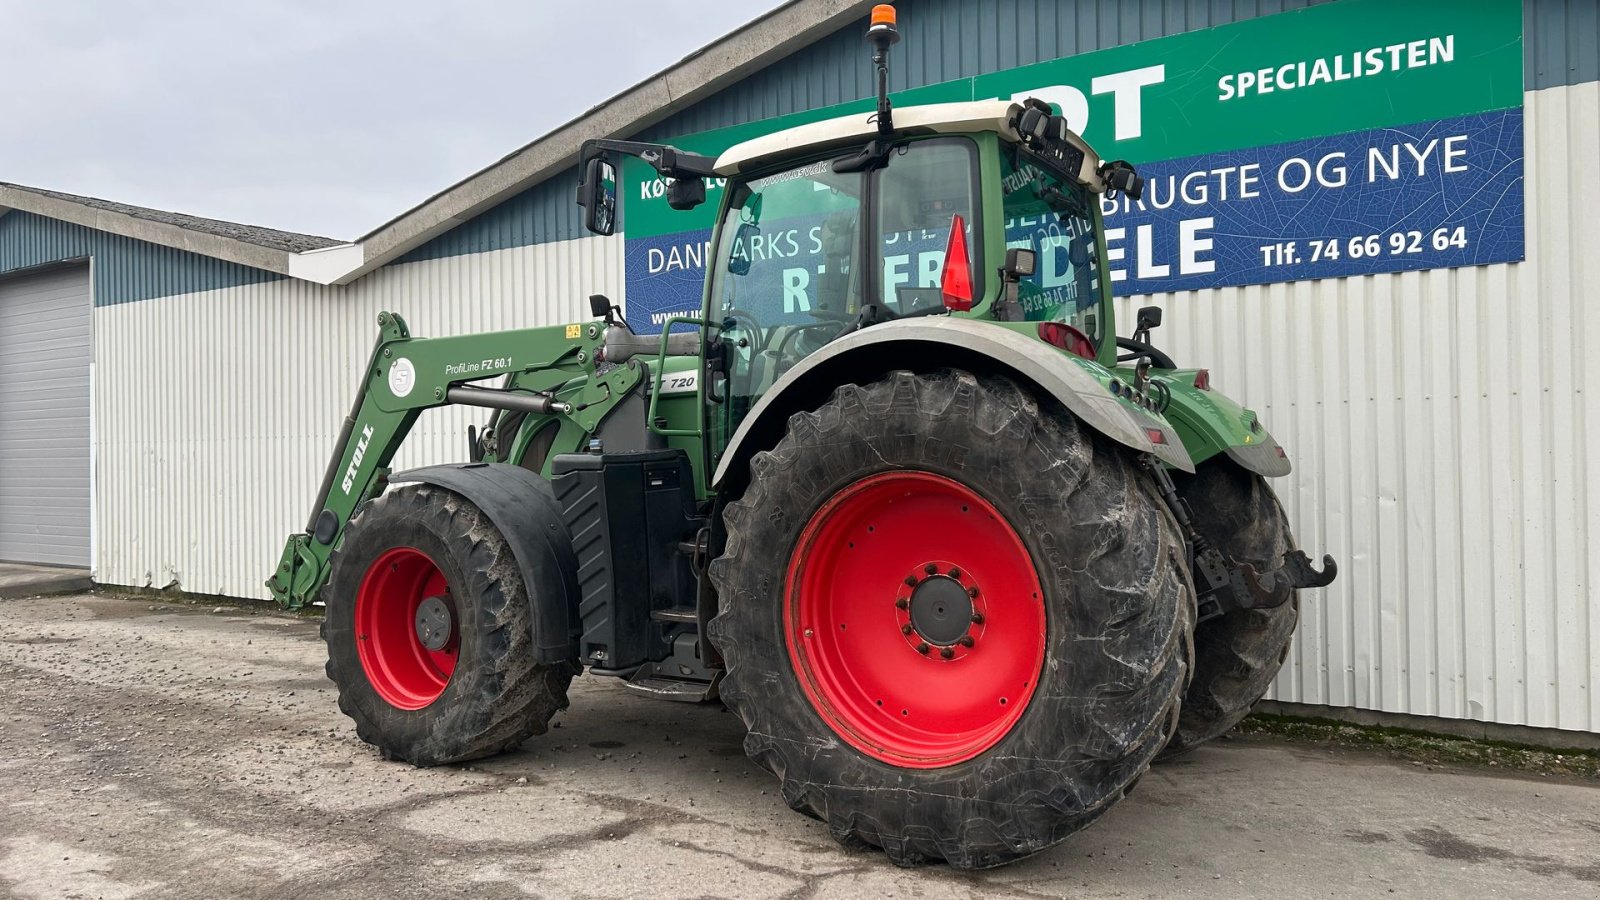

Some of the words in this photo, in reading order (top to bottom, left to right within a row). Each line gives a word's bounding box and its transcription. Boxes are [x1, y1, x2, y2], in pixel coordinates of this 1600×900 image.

[1218, 34, 1454, 101] SPECIALISTEN
[1277, 152, 1347, 193] OG
[1368, 135, 1468, 183] NYE
[1260, 241, 1301, 267] Tlf.
[1309, 239, 1340, 262] 74
[1348, 235, 1381, 258] 66
[1389, 230, 1423, 255] 92
[1432, 226, 1467, 250] 64
[445, 362, 480, 375] ProfiLine
[481, 359, 493, 370] FZ
[494, 357, 512, 369] 60.1
[671, 376, 695, 389] 720
[341, 423, 374, 496] STOLL
